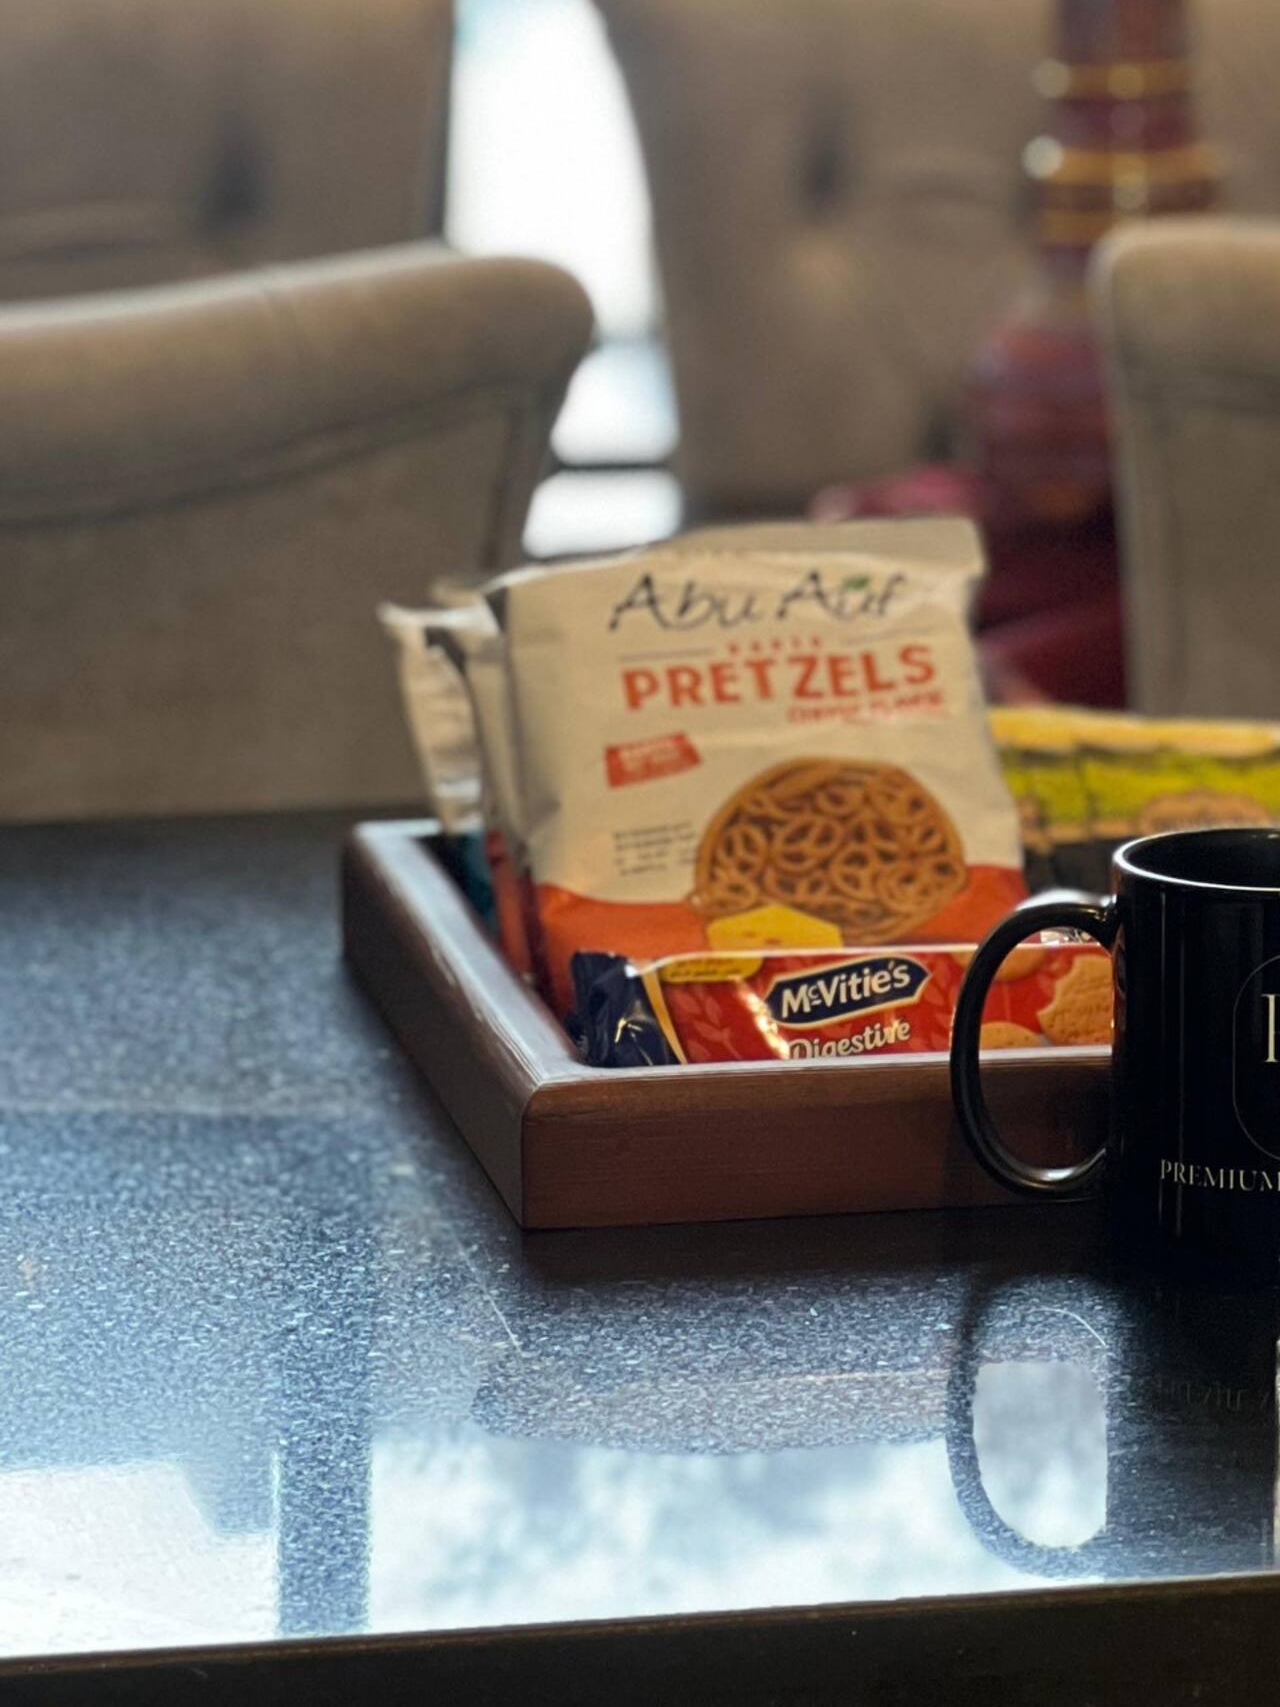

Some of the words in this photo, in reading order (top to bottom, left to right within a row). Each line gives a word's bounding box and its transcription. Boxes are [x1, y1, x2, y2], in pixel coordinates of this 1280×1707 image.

[607, 572, 764, 632] Abu
[620, 642, 938, 713] PRETZELS
[780, 959, 911, 1019] McVitie's
